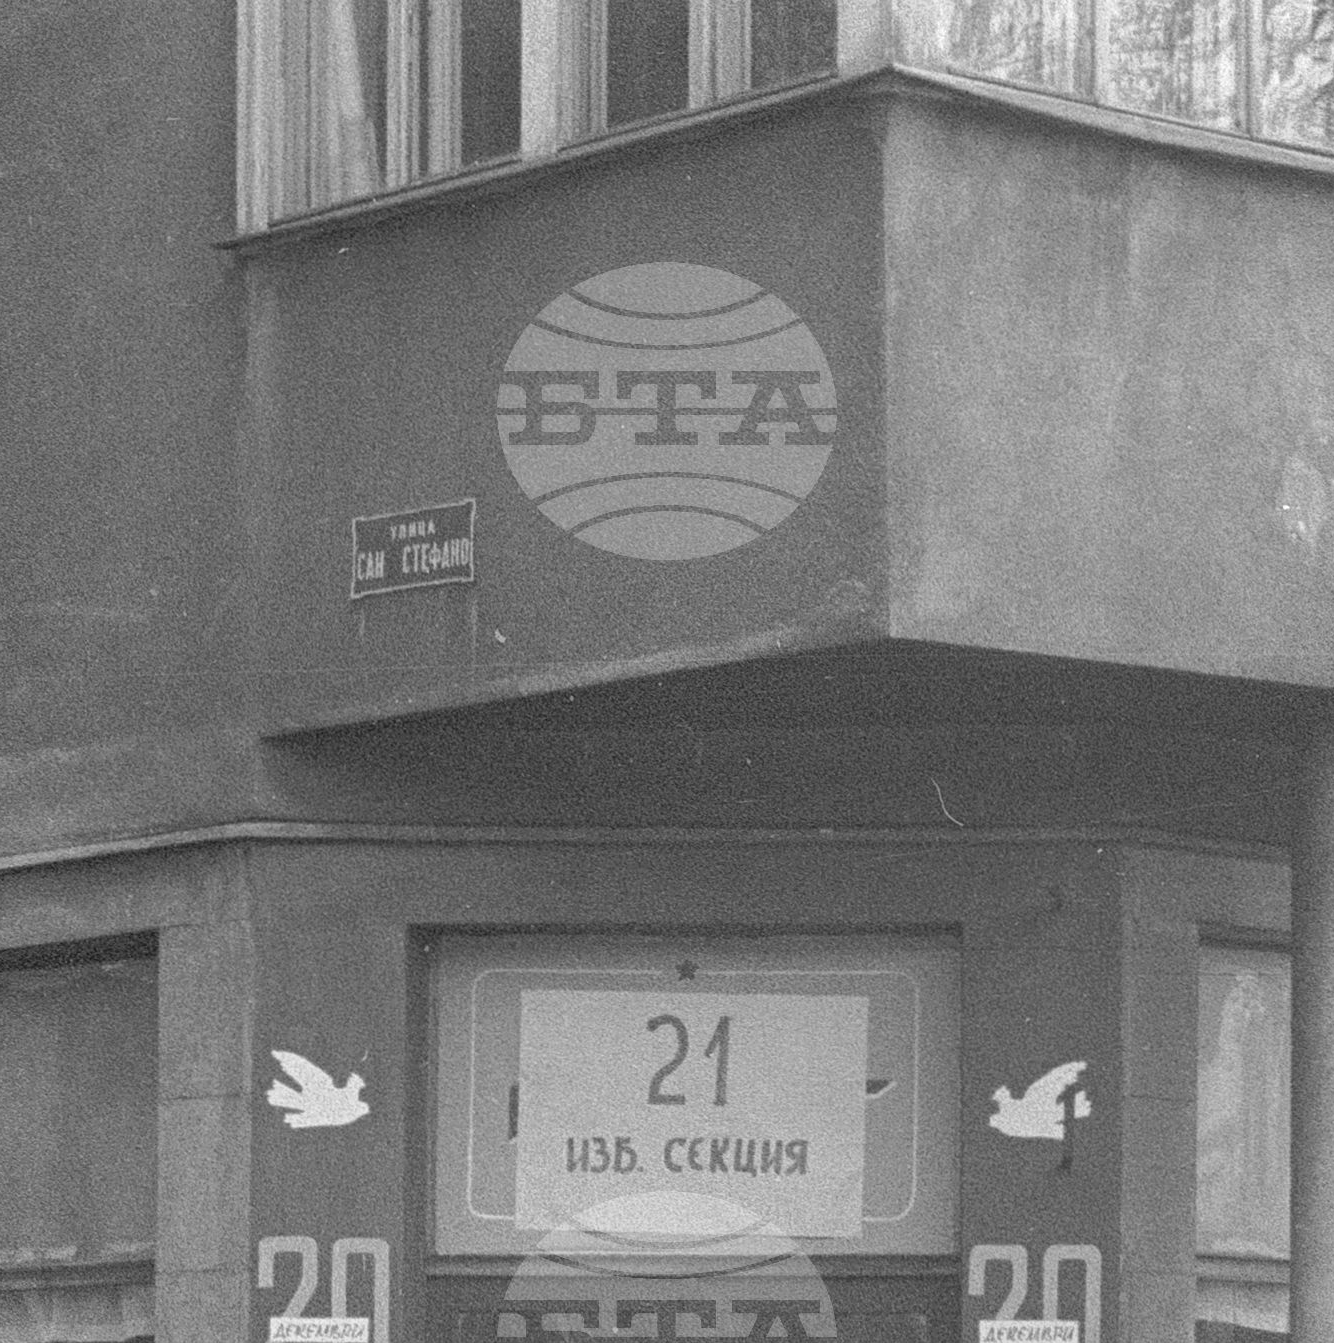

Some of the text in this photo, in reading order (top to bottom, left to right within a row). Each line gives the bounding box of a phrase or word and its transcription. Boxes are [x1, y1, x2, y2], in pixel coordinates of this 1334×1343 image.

[390, 518, 436, 541] УЛИЦА
[357, 537, 470, 581] САН СТЕФАНО
[646, 1014, 731, 1107] 21
[566, 1136, 809, 1178] ИЗБ. СЕКЦИЯ
[273, 1322, 366, 1341] ДЕКЕМВРИ
[984, 1325, 1075, 1343] ДЕКЕМВРИ
